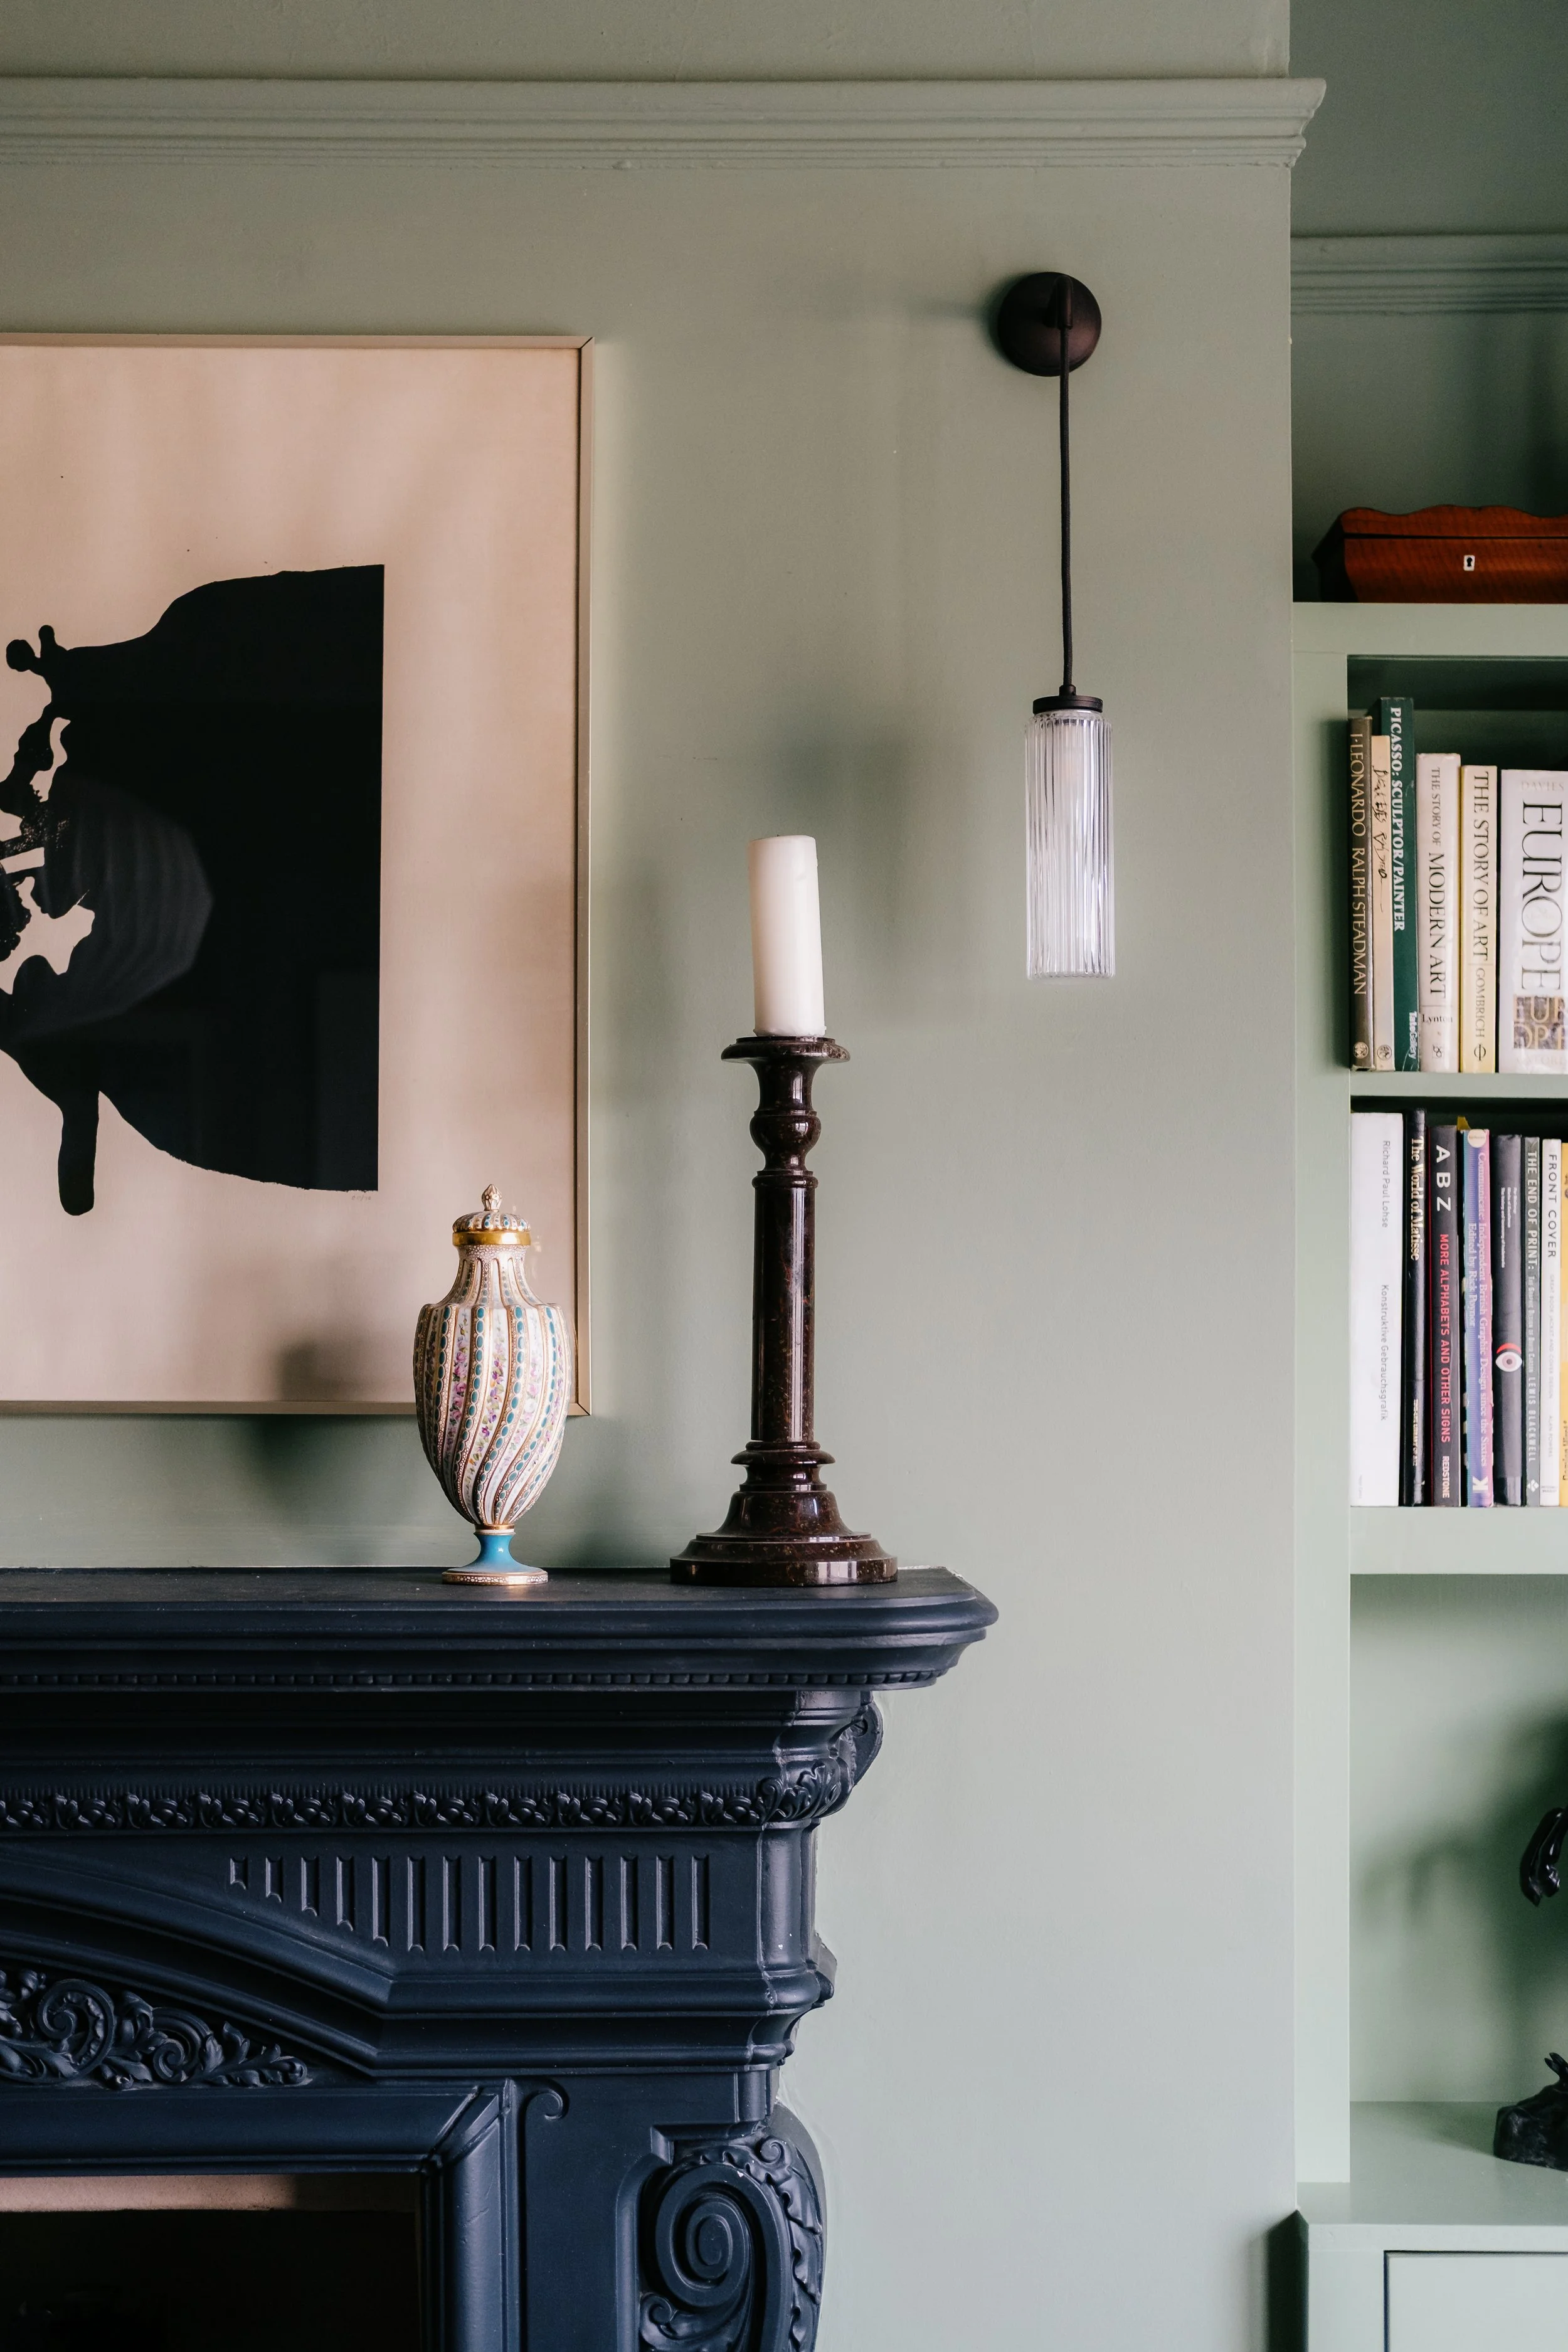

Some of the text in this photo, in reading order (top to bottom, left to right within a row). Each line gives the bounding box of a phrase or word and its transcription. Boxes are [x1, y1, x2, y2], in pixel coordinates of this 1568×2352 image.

[1391, 707, 1405, 931] PICASSO: SCULPTOR/PAINTER
[1473, 771, 1489, 961] THE STORY OF ART
[1352, 848, 1366, 901] RALPH
[1429, 766, 1446, 999] THE STORY OF MODERN ART
[1522, 800, 1563, 990] EUROPE
[1352, 902, 1367, 995] STEADMAN
[1422, 1014, 1453, 1024] Lynton
[1475, 968, 1486, 1038] GOMBRICH
[1382, 1140, 1391, 1228] Richard Paul Lohse
[1411, 1136, 1424, 1261] The World of Matisse
[1528, 1151, 1538, 1270] THE END OF PRINT:
[1548, 1154, 1557, 1258] FRONT COVER
[1469, 1223, 1477, 1327] Edited by Rick Poynor
[1478, 1224, 1486, 1281] Independent
[1379, 1285, 1390, 1421] Konstruktive Gebrauchsgrafik
[1441, 1234, 1449, 1443] MORE ALPHABETS AND OTHER SIGNS
[1478, 1318, 1487, 1355] Graphic
[1478, 1359, 1487, 1390] Design
